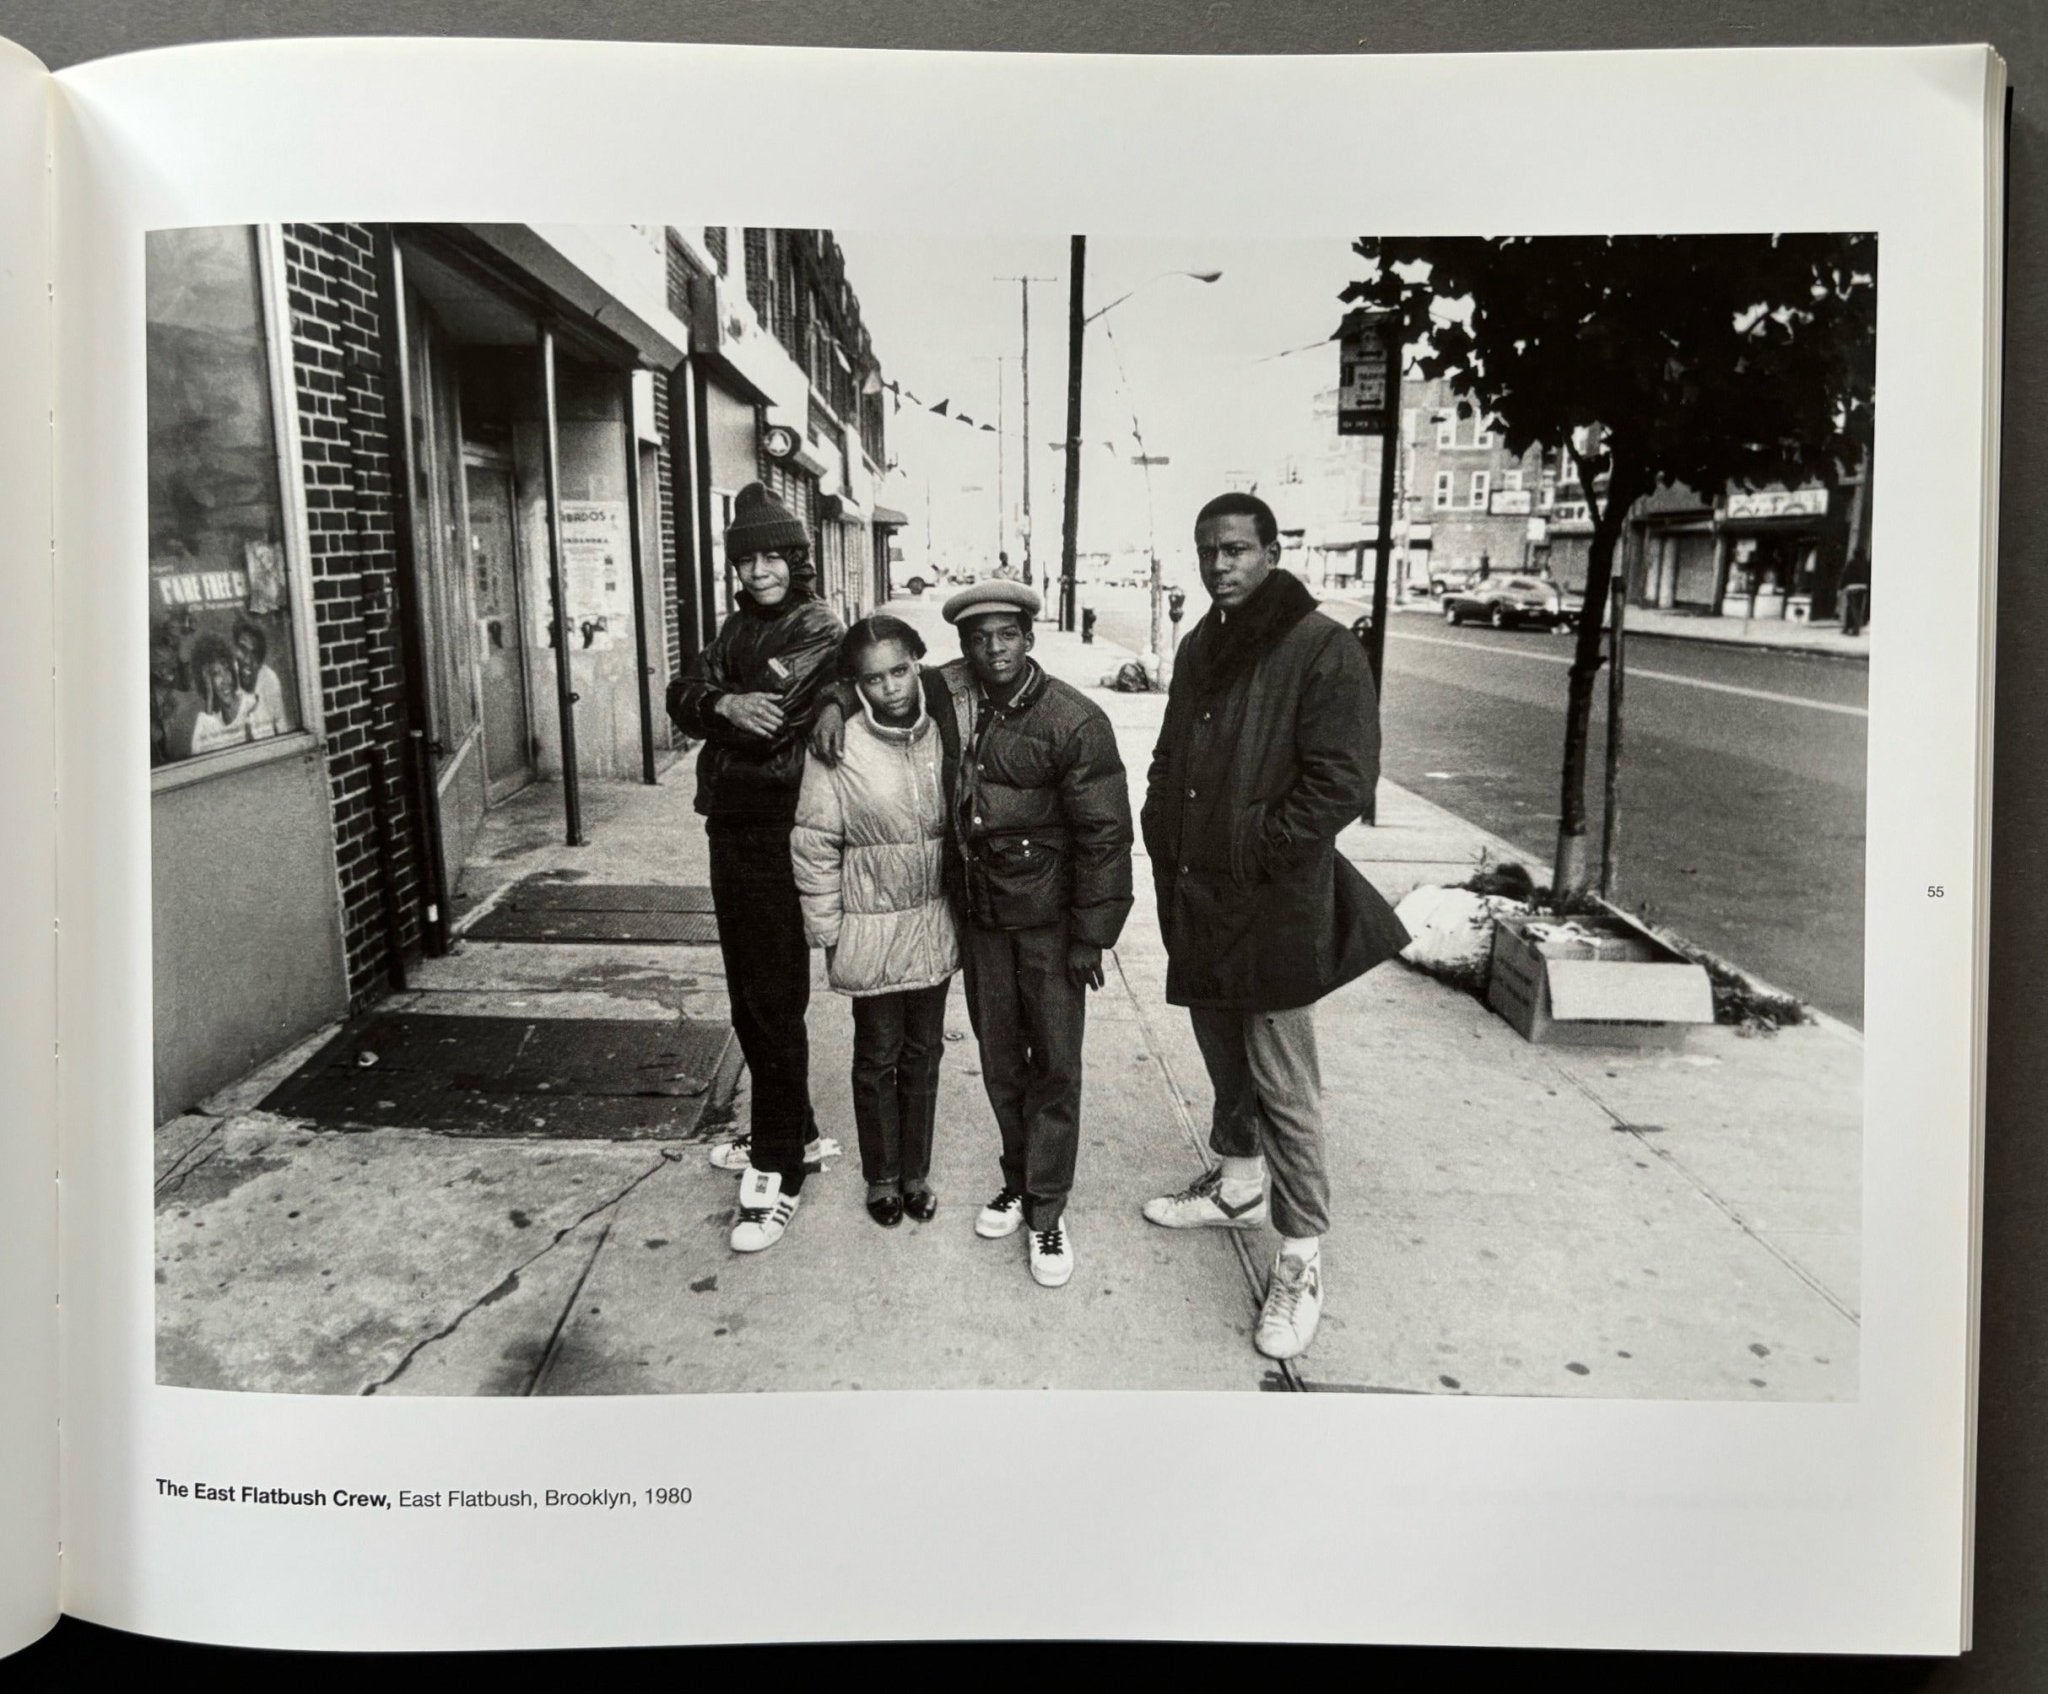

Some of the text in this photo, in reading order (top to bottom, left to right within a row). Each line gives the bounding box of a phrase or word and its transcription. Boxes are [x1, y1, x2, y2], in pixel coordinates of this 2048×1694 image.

[1927, 885, 1945, 898] 55
[155, 1478, 693, 1511] The East Flatbush Crew, East Flatbush, Brooklyn, 1980
